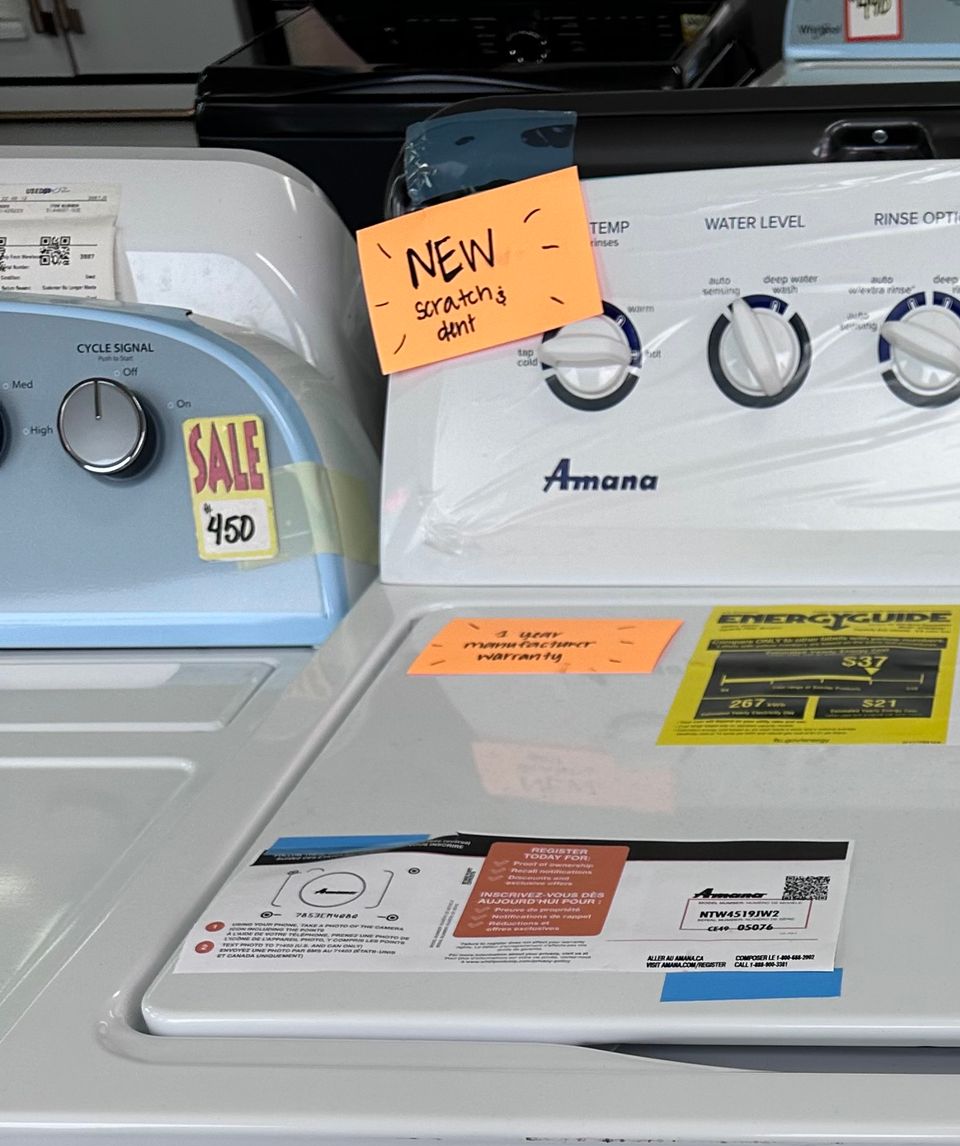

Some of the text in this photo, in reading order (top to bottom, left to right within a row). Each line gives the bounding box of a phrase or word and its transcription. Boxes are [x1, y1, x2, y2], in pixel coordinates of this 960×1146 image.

[705, 215, 805, 230] WATER LEVEL
[874, 212, 918, 226] RINSE
[590, 221, 629, 234] TEMP
[591, 239, 619, 247] rinses
[406, 228, 494, 289] NEW
[709, 277, 731, 285] auto
[763, 276, 788, 284] deep
[416, 285, 493, 320] scratch
[438, 315, 477, 342] dent
[77, 344, 154, 353] CYCLE SIGNAL
[517, 358, 538, 367] cold
[123, 368, 138, 376] Off
[12, 380, 33, 389] Med
[176, 400, 191, 408] On
[30, 425, 53, 435] High
[188, 420, 265, 494] SALE
[543, 458, 658, 492] Amana
[718, 613, 952, 628] ENERGYGUIDE
[520, 631, 562, 639] year
[464, 641, 596, 649] manufacturer
[477, 652, 563, 662] warranty
[841, 656, 888, 667] $37
[729, 699, 766, 708] 267
[862, 699, 897, 708] $21
[692, 888, 767, 898] Amana
[700, 910, 780, 918] NTW4519JW2
